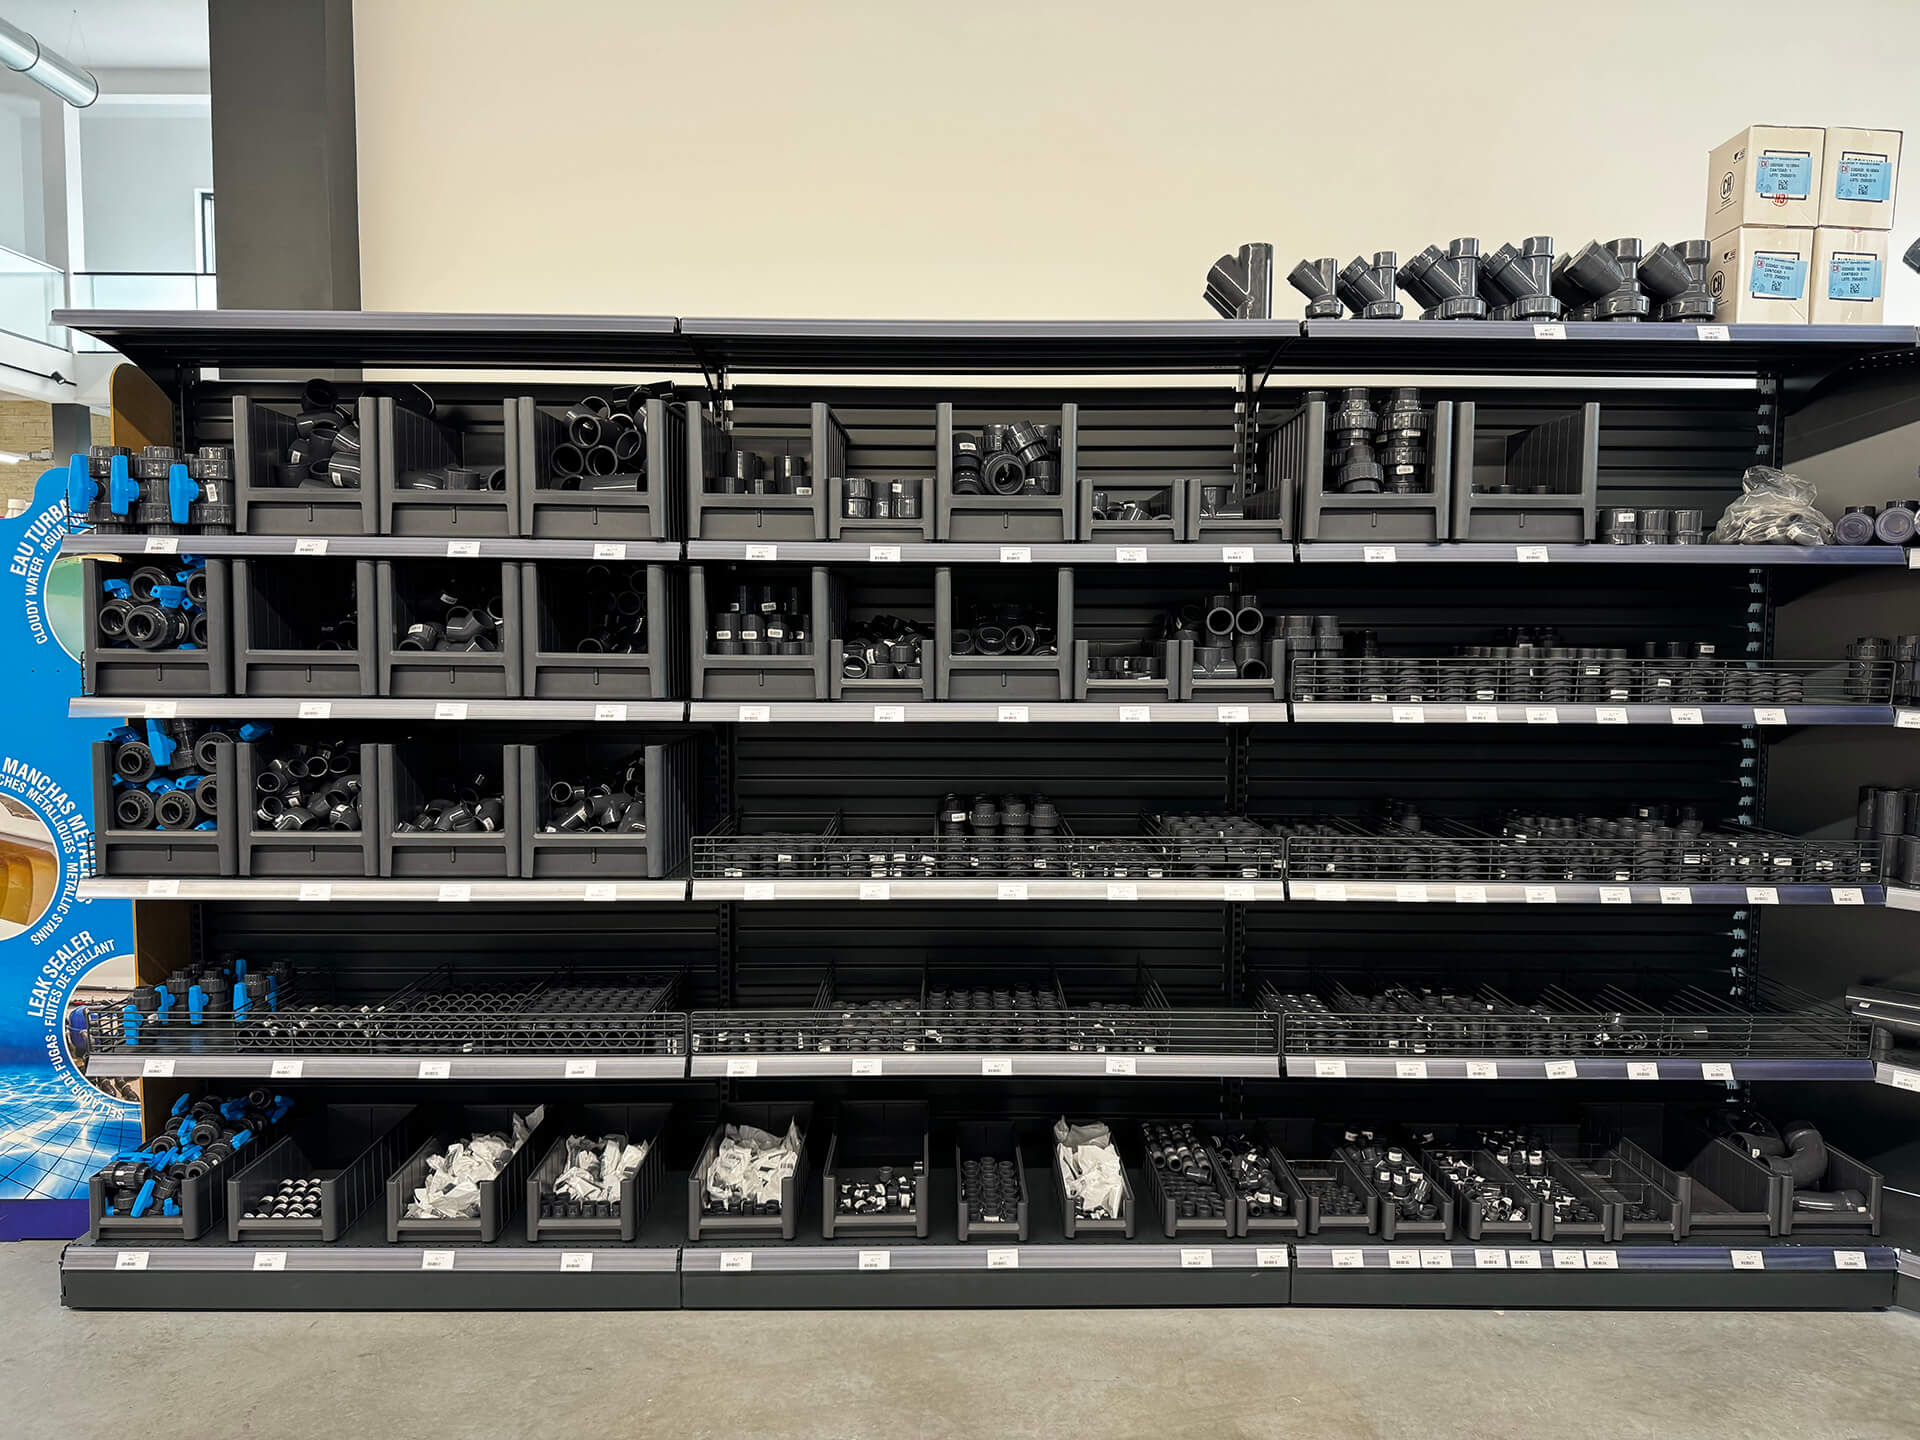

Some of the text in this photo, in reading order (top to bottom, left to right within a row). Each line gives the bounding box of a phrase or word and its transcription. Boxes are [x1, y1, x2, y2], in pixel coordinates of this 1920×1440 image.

[10, 541, 35, 577] EAU
[25, 524, 68, 645] CLOUDY WATER AGUA
[2, 757, 76, 815] MANCHAS
[26, 787, 76, 854] METALLIQUES
[57, 862, 78, 915] METALLIC
[31, 913, 63, 945] STAINS
[27, 930, 95, 1018] LEAK SEALER
[65, 939, 116, 976] SCELLANT
[55, 973, 71, 989] DE
[44, 988, 63, 1026] FUITES
[45, 1034, 67, 1072] FUGAS
[59, 1070, 75, 1087] DE
